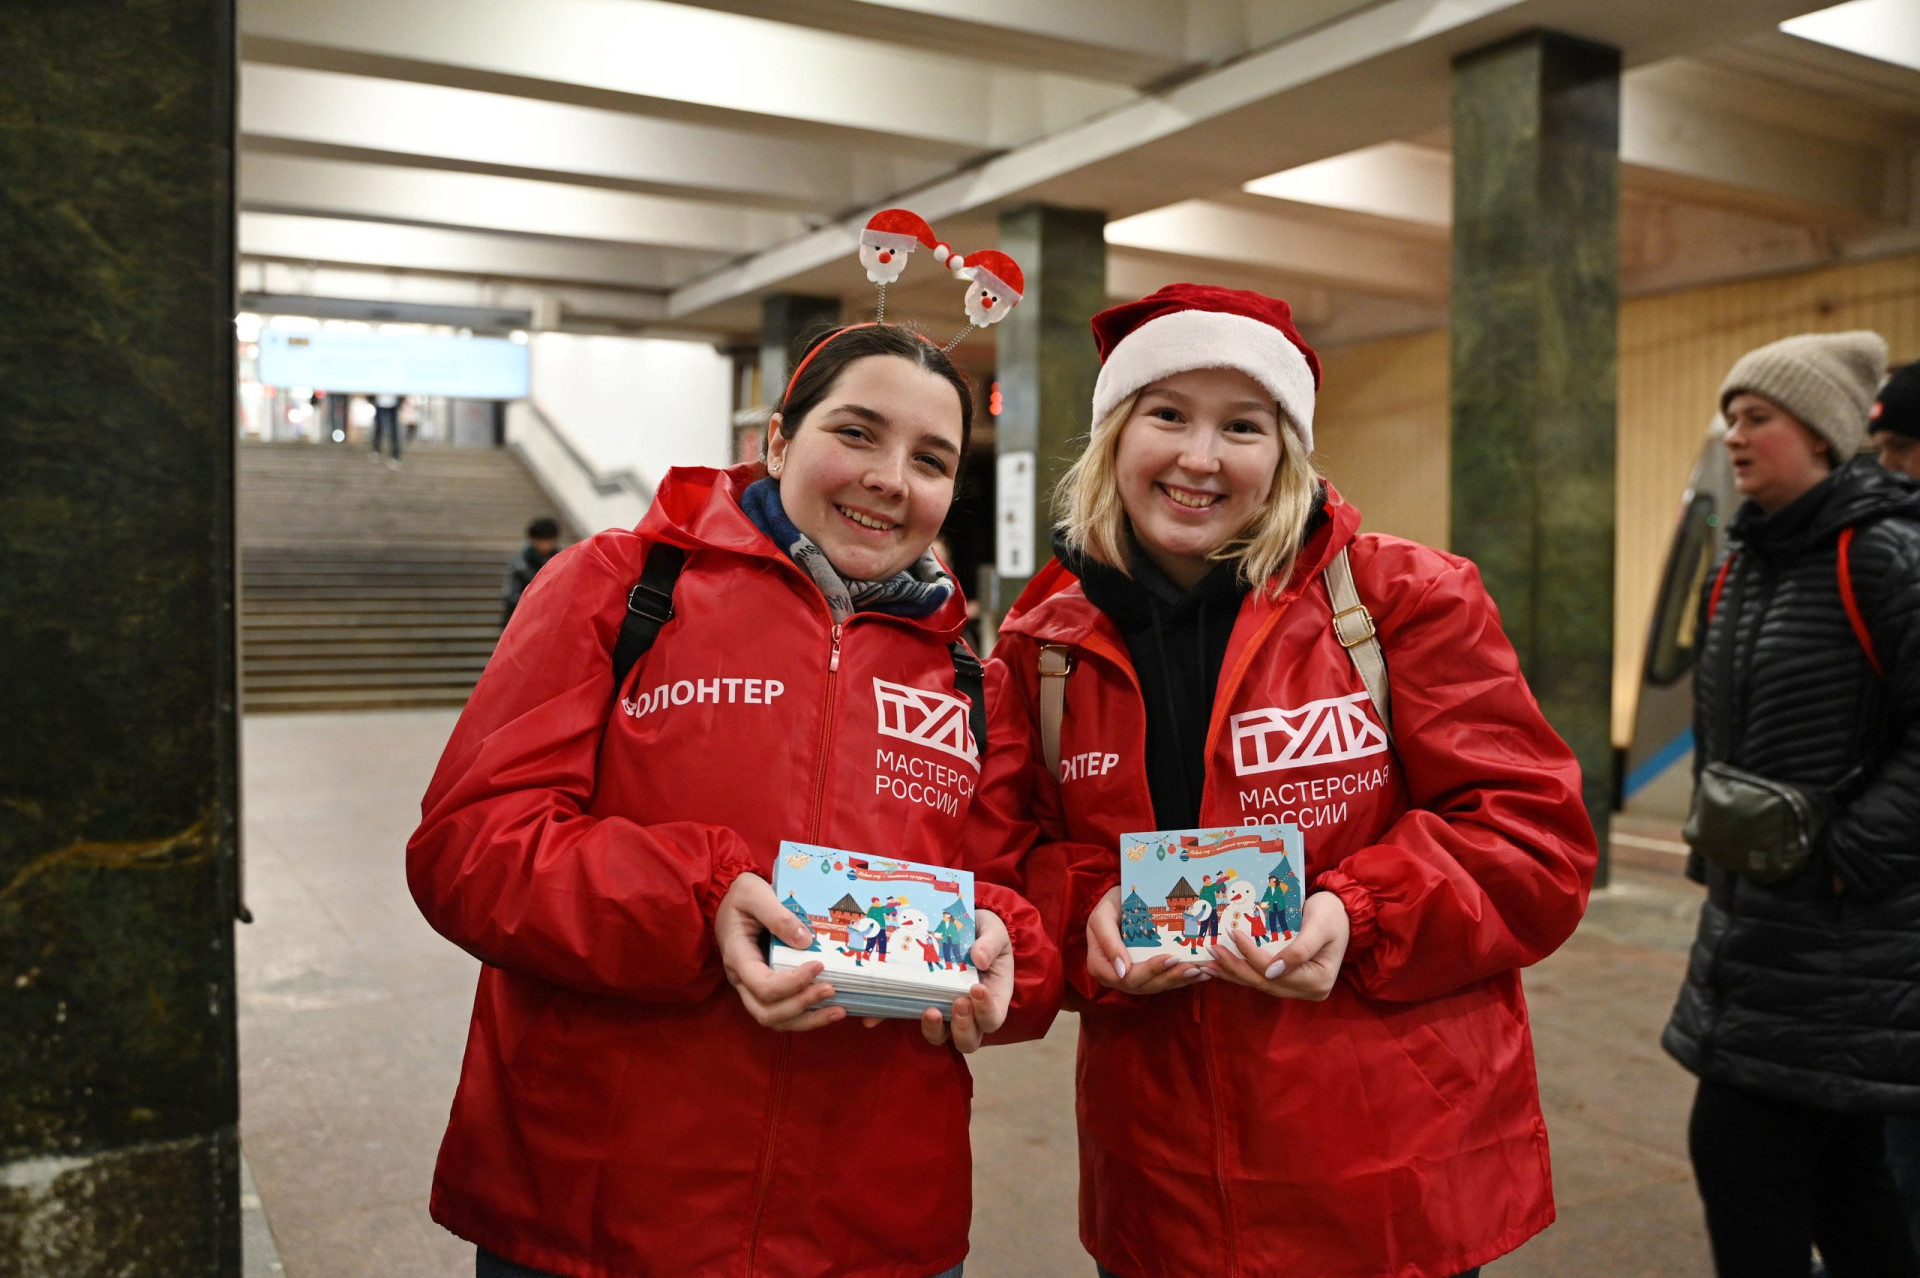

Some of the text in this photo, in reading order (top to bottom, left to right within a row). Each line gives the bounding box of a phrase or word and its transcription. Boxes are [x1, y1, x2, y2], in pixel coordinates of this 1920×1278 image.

[875, 774, 959, 818] РОССИИ
[876, 748, 975, 799] МАСТЕРСК
[1239, 764, 1389, 811] МАСТЕРСКАЯ
